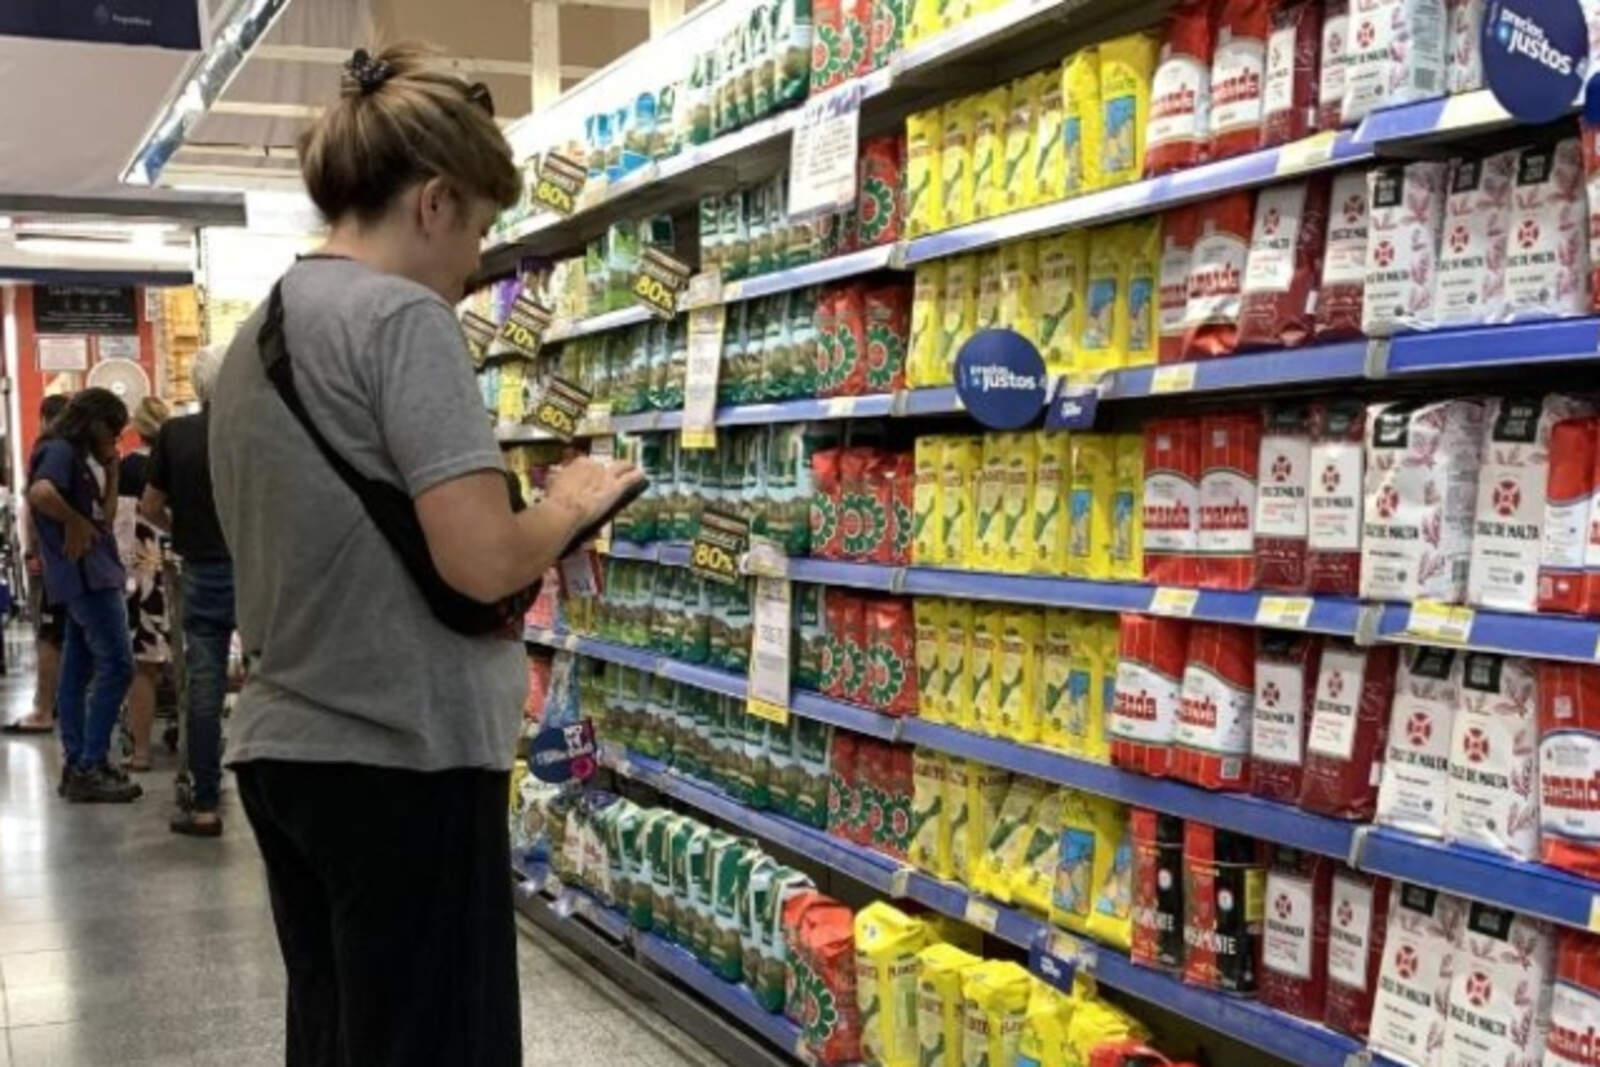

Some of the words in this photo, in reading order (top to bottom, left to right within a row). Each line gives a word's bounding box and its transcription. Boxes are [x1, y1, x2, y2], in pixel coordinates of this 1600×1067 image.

[1507, 29, 1573, 76] justos
[636, 274, 674, 309] 80%
[504, 321, 536, 350] 70%
[982, 371, 1037, 393] justos
[695, 543, 734, 573] 80%
